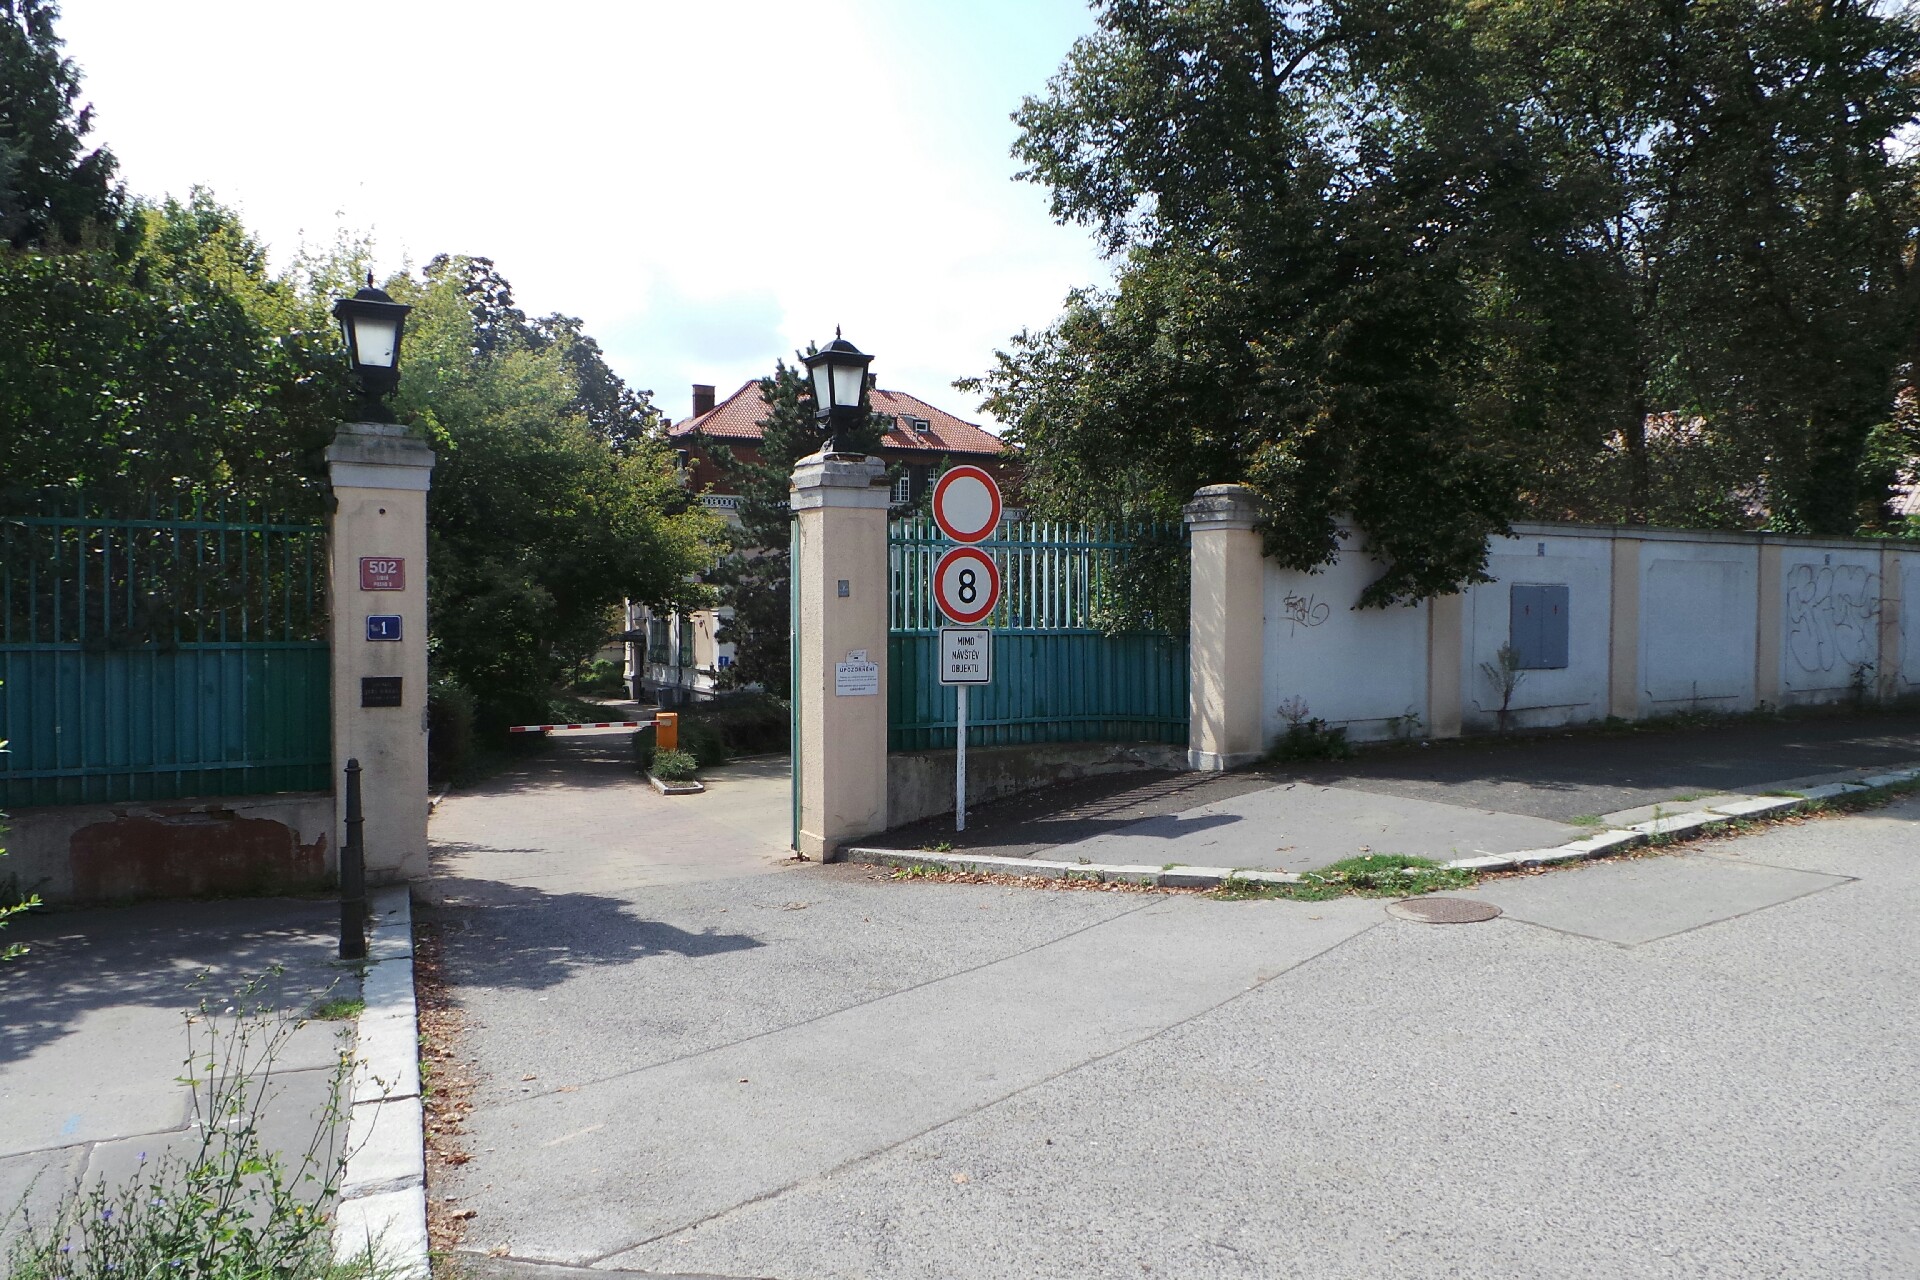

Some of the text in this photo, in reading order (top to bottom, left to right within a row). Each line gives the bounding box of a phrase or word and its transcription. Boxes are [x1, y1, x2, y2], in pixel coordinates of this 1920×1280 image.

[369, 561, 397, 574] 502
[958, 568, 977, 604] 8
[381, 621, 387, 635] 1
[957, 636, 975, 646] MIMO
[951, 648, 980, 660] NÁVŠTĚV
[951, 664, 979, 673] OBJEKTU
